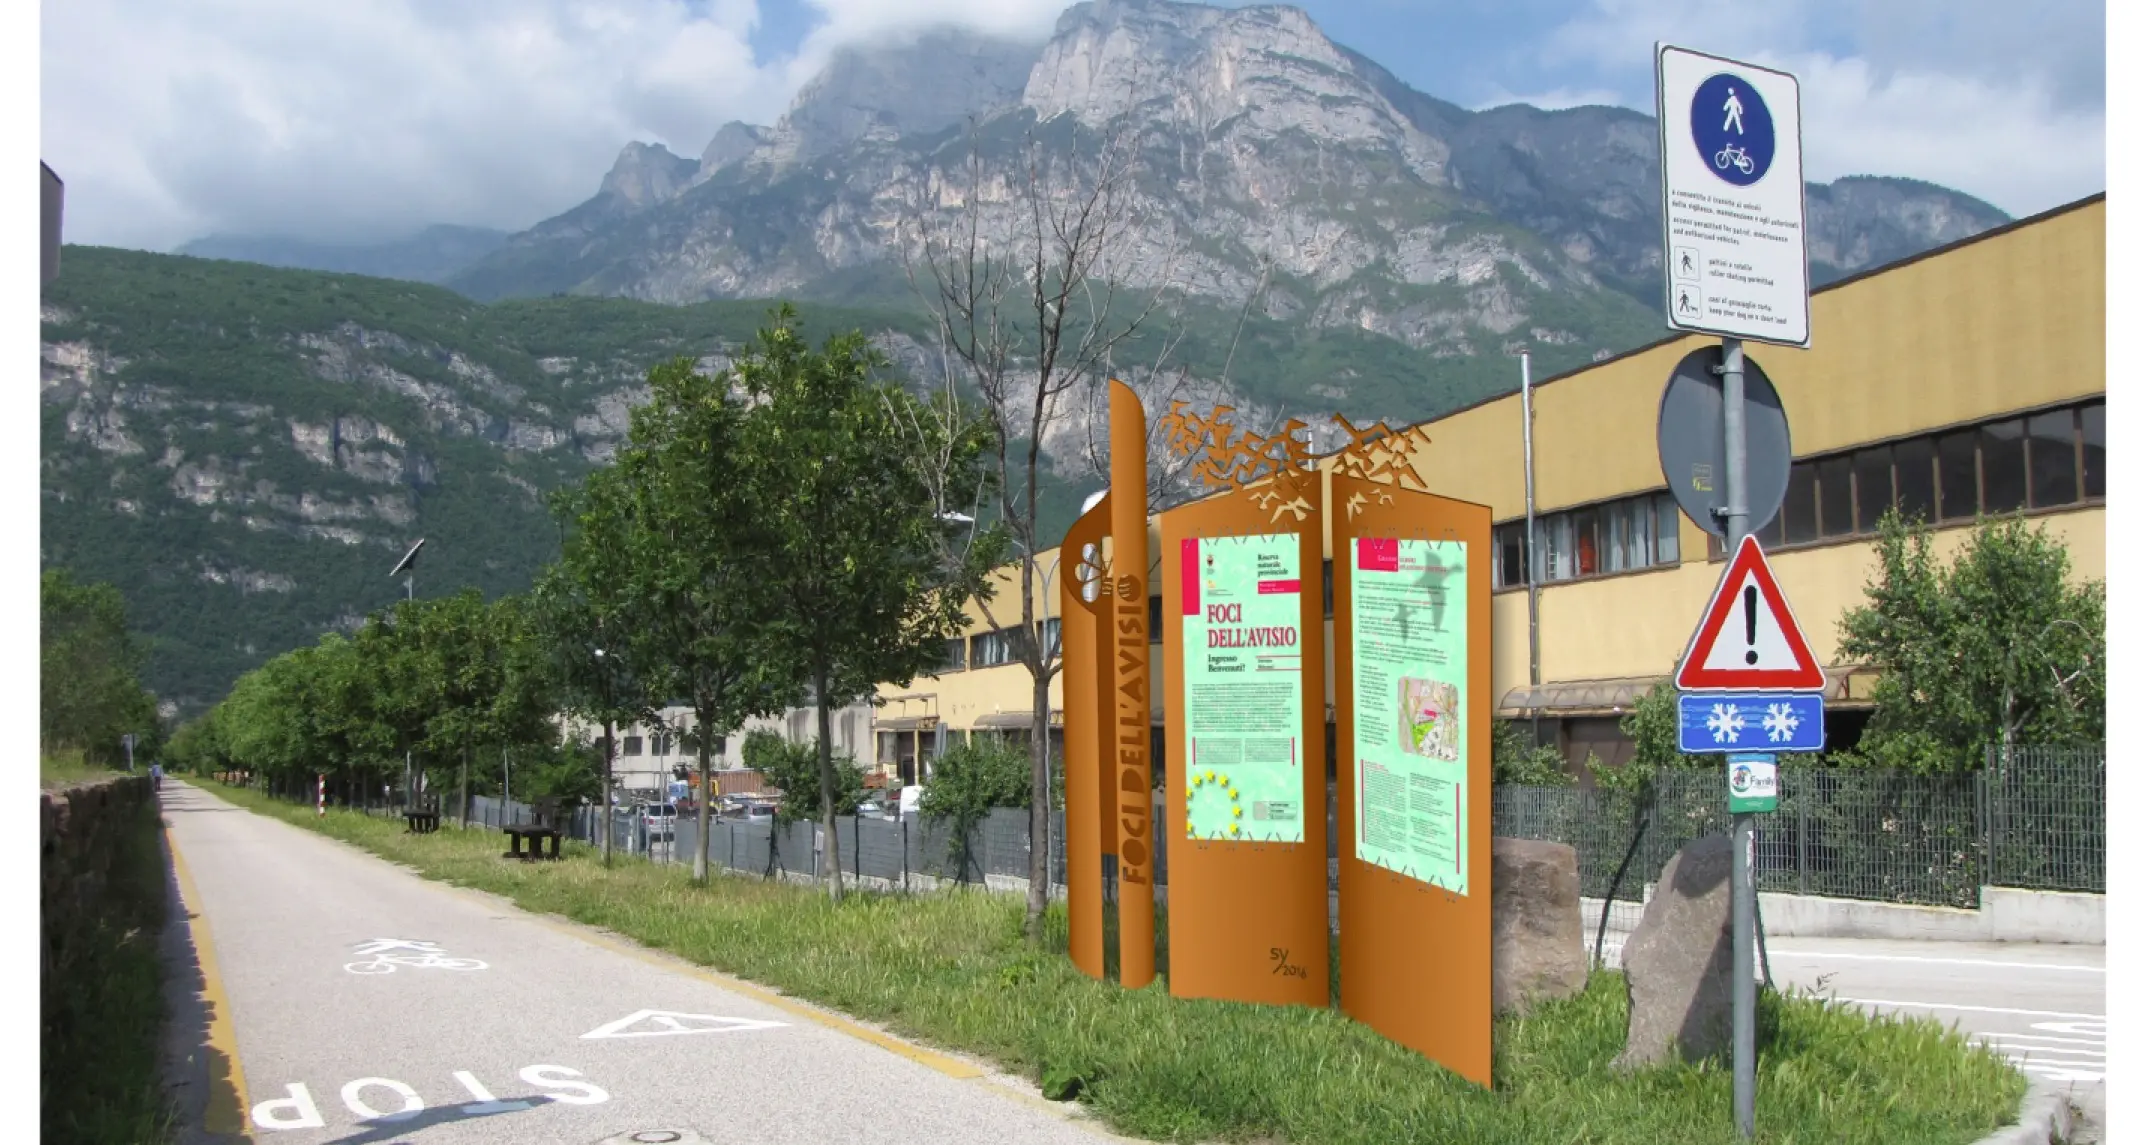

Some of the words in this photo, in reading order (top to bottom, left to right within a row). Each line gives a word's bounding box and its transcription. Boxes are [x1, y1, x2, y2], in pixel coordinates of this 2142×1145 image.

[1206, 603, 1242, 624] FOCI
[1207, 626, 1297, 649] DELL'AVISIO
[1208, 654, 1238, 665] Ingresso
[1117, 573, 1145, 793] DELL'AVISIO
[1121, 803, 1147, 885] FOCI
[252, 1063, 610, 1130] STOP
